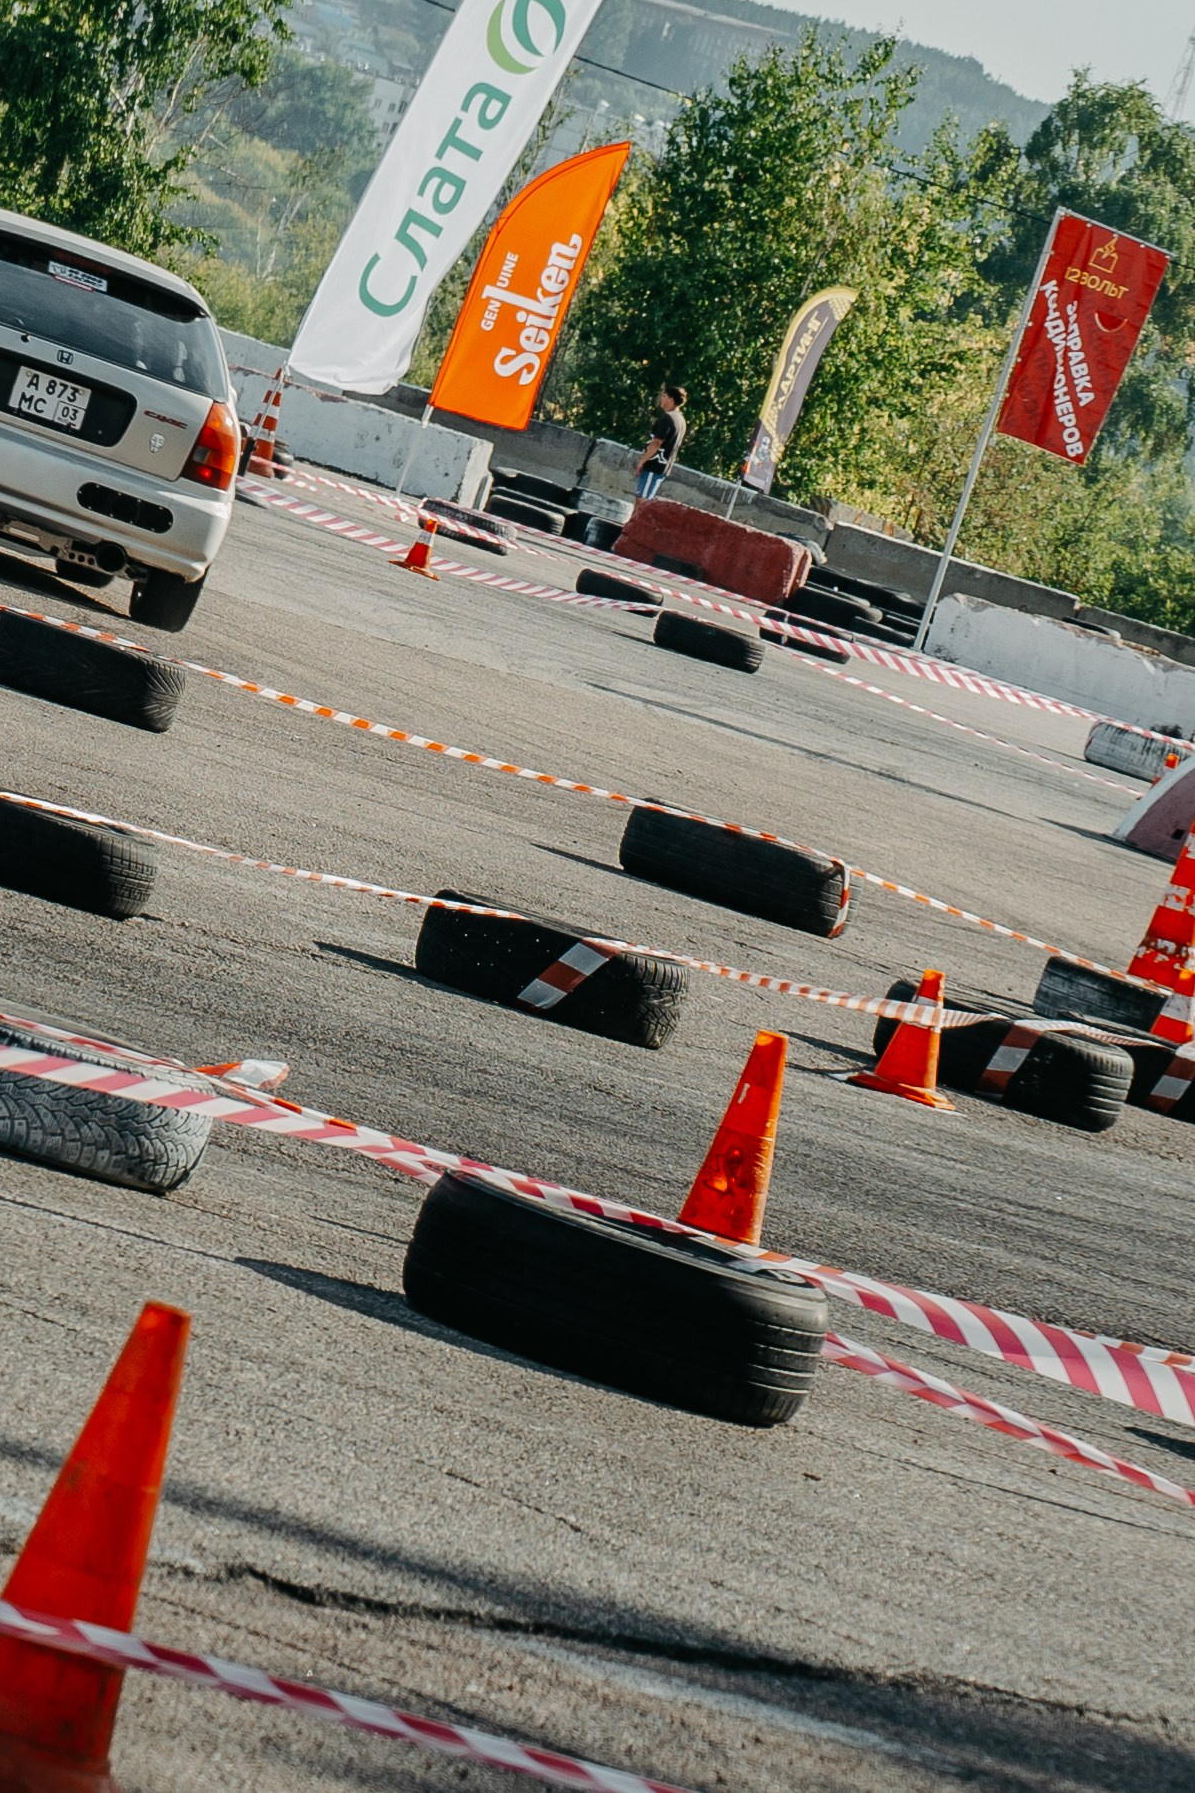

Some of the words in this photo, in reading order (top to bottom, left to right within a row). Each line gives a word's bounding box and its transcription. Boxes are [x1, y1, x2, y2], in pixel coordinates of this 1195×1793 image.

[357, 81, 513, 318] Слата
[481, 233, 583, 386] Seiken
[45, 379, 80, 403] 873
[61, 406, 79, 421] 03
